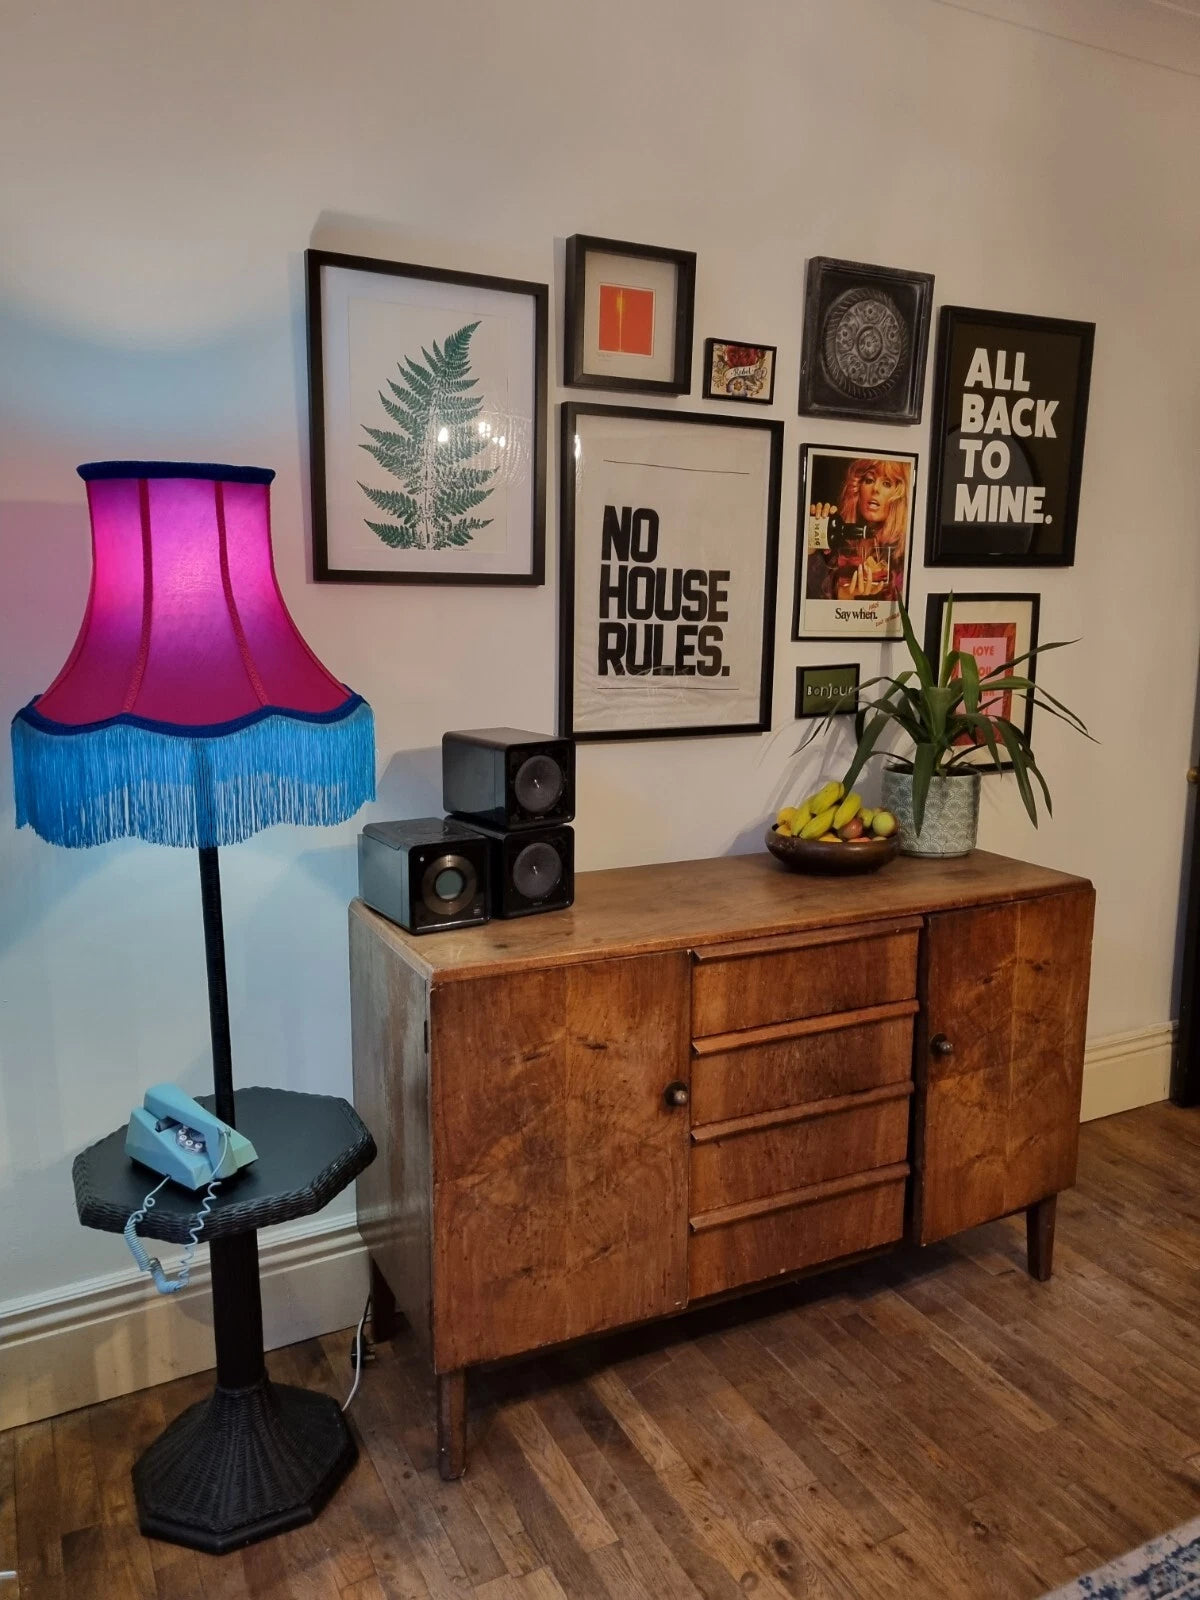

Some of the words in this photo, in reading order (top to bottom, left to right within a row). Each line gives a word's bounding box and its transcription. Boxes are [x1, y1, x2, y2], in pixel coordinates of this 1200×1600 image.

[964, 347, 1030, 392] ALL
[960, 393, 1059, 438] BACK
[959, 438, 1011, 480] TO
[954, 483, 1053, 525] MINE.
[601, 504, 660, 563] NO
[599, 564, 730, 622] HOUSE
[835, 607, 851, 622] Say
[852, 607, 878, 621] when.
[597, 621, 731, 677] RULES.
[972, 645, 995, 656] LOVE
[807, 683, 853, 699] Bonjour
